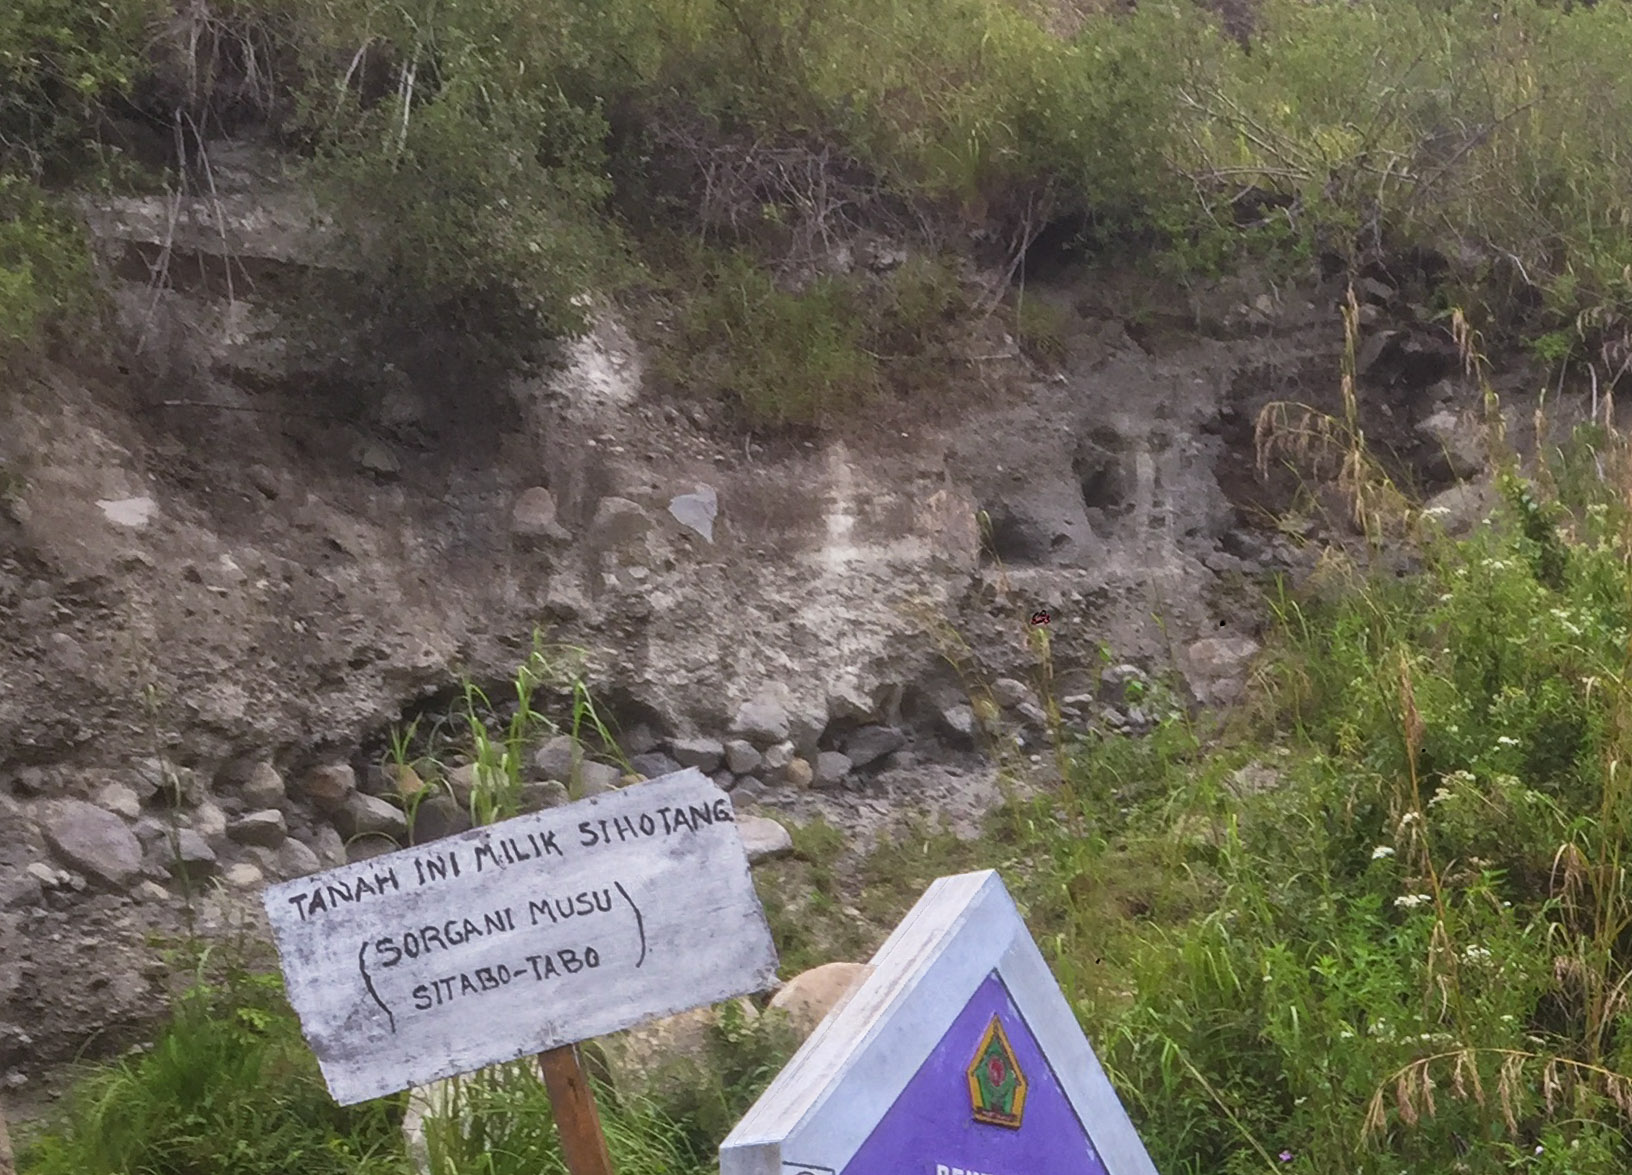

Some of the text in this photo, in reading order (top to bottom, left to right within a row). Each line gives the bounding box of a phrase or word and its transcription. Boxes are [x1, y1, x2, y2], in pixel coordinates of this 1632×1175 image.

[289, 798, 735, 921] TANAH INI MILIK SIHOTANG
